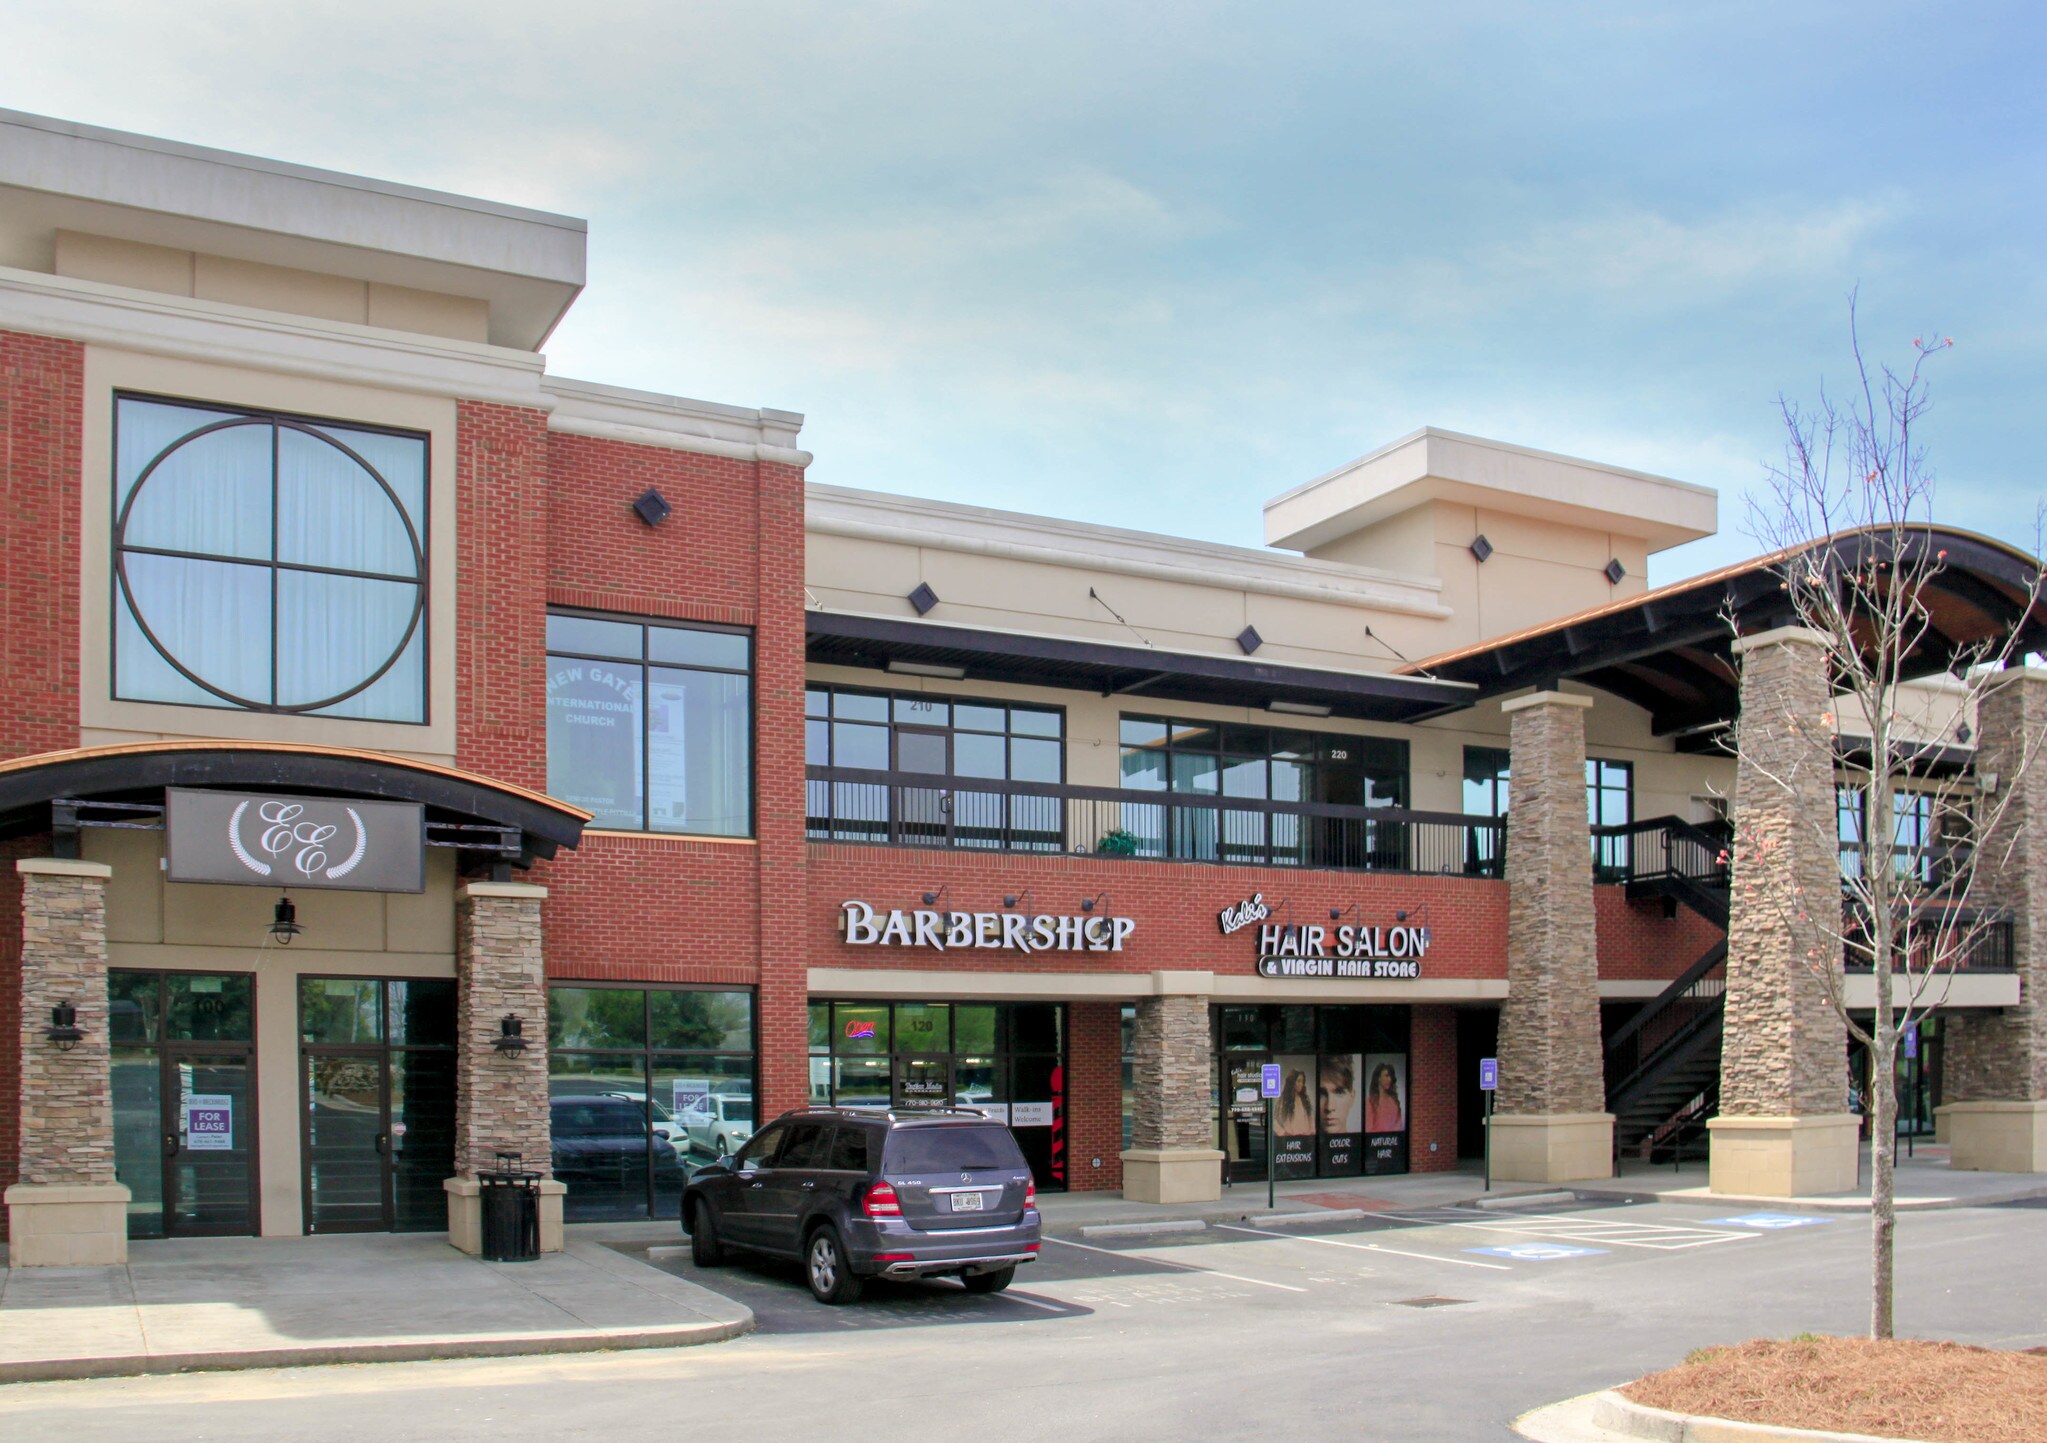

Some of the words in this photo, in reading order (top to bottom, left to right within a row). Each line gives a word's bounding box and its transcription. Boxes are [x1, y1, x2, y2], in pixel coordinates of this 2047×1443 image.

[547, 667, 582, 694] NEW
[590, 668, 634, 700] GATE
[910, 701, 932, 712] 210
[566, 714, 615, 726] CHURCH
[1331, 749, 1347, 760] 220
[590, 797, 615, 805] PASTOR
[842, 900, 1135, 953] BARBERSHOP
[1259, 925, 1325, 956] HAIR
[1336, 925, 1425, 957] SALON
[1266, 961, 1277, 974] &
[1281, 959, 1333, 976] VIRGIN
[1337, 960, 1371, 976] HAIR
[1374, 961, 1417, 977] STORE
[193, 999, 225, 1014] 100
[845, 1020, 876, 1037] Open
[911, 1020, 933, 1032] 120
[683, 1094, 700, 1102] FOR
[199, 1112, 220, 1120] FOR
[194, 1122, 224, 1131] LEASE
[1286, 1141, 1302, 1150] HAIR
[1329, 1138, 1351, 1148] COLOR
[1370, 1136, 1399, 1146] NATURAL
[1275, 1153, 1312, 1163] EXTENSIONS
[1332, 1154, 1349, 1164] CUTS
[1377, 1149, 1392, 1159] HAIR
